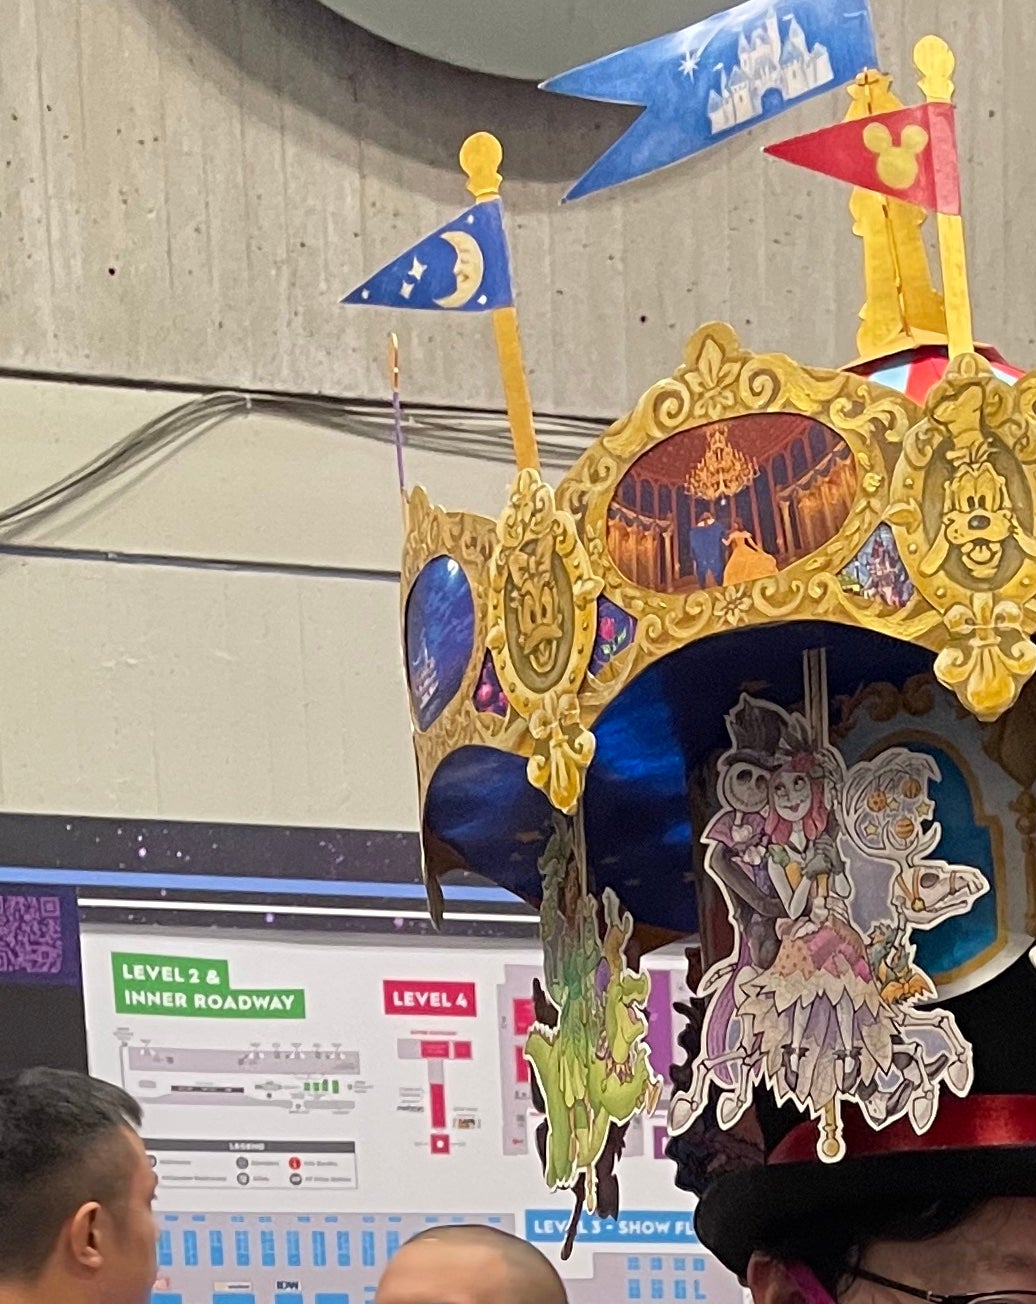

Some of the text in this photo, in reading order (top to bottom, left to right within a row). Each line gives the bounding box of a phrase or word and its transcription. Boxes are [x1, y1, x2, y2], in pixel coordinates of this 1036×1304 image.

[122, 964, 221, 985] LEVEL 2 &
[124, 989, 295, 1011] INNER ROADWAY
[393, 991, 469, 1009] LEVEL 4
[533, 1219, 589, 1235] LEVL
[591, 1220, 601, 1235] 3
[618, 1220, 669, 1235] SHOW
[674, 1221, 695, 1235] FL
